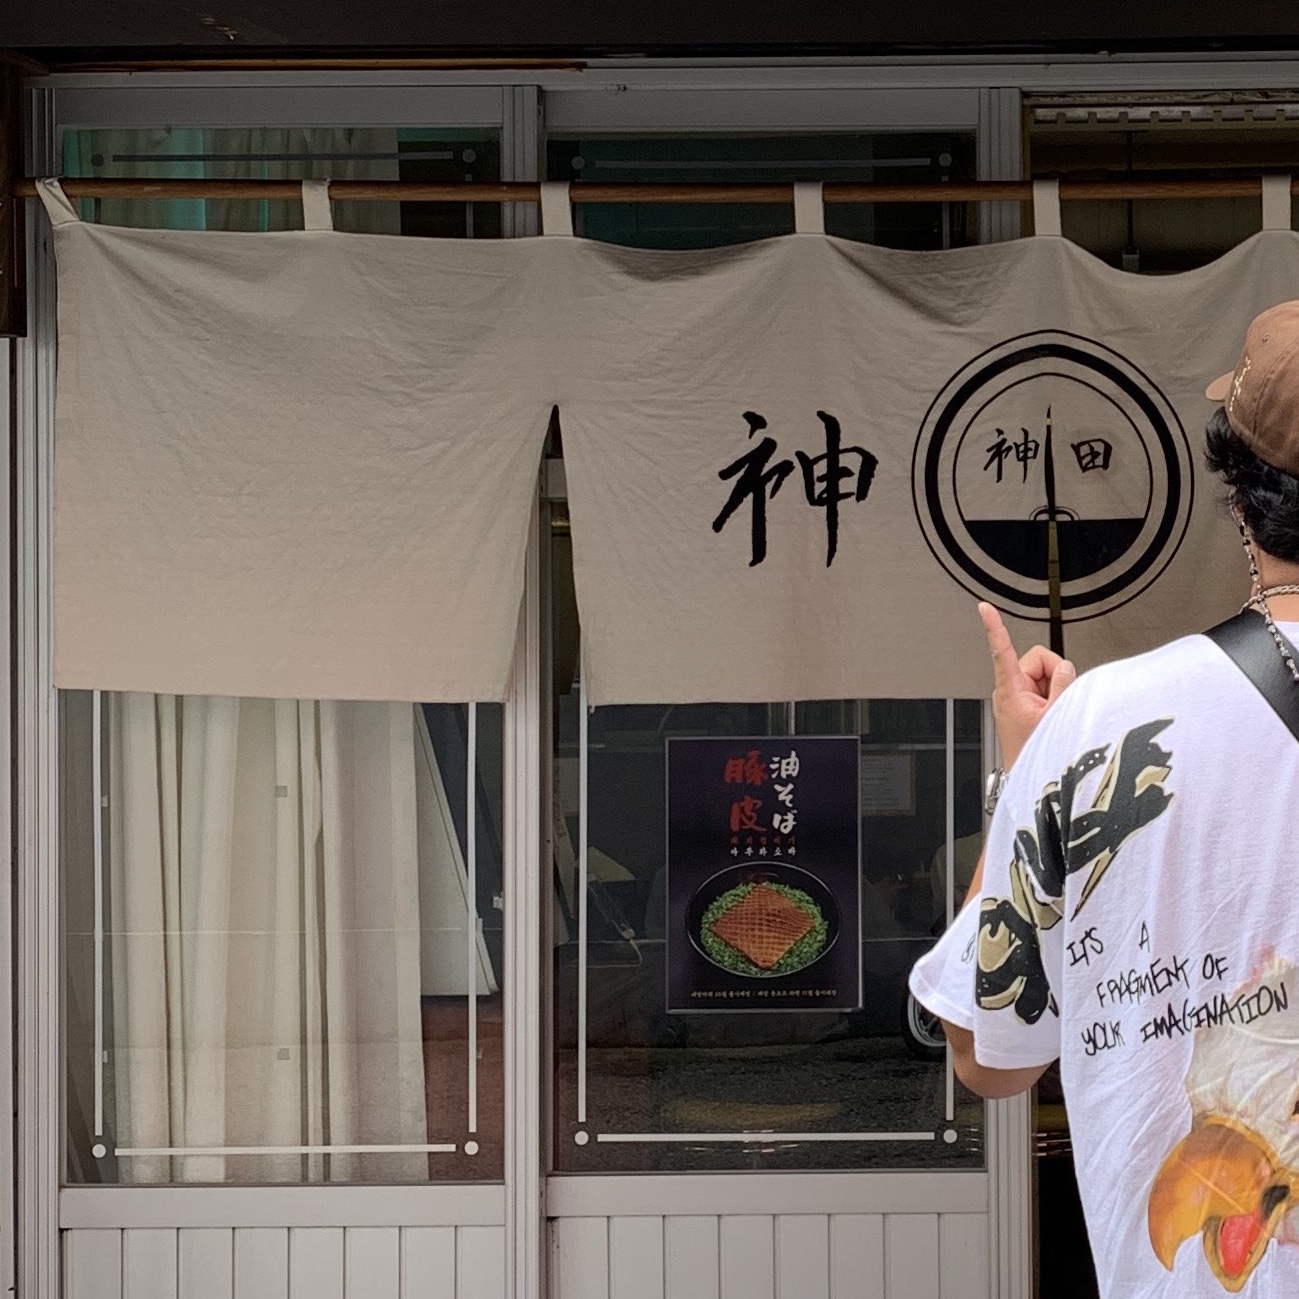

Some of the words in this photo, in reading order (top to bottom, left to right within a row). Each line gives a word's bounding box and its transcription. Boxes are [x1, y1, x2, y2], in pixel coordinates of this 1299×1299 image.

[712, 410, 880, 568] 神
[1139, 920, 1150, 953] A
[1096, 955, 1191, 1008] FRAGMENT
[1202, 953, 1229, 981] OF
[1081, 1019, 1126, 1056] YOUR
[1140, 981, 1289, 1043] IMAGINATION
